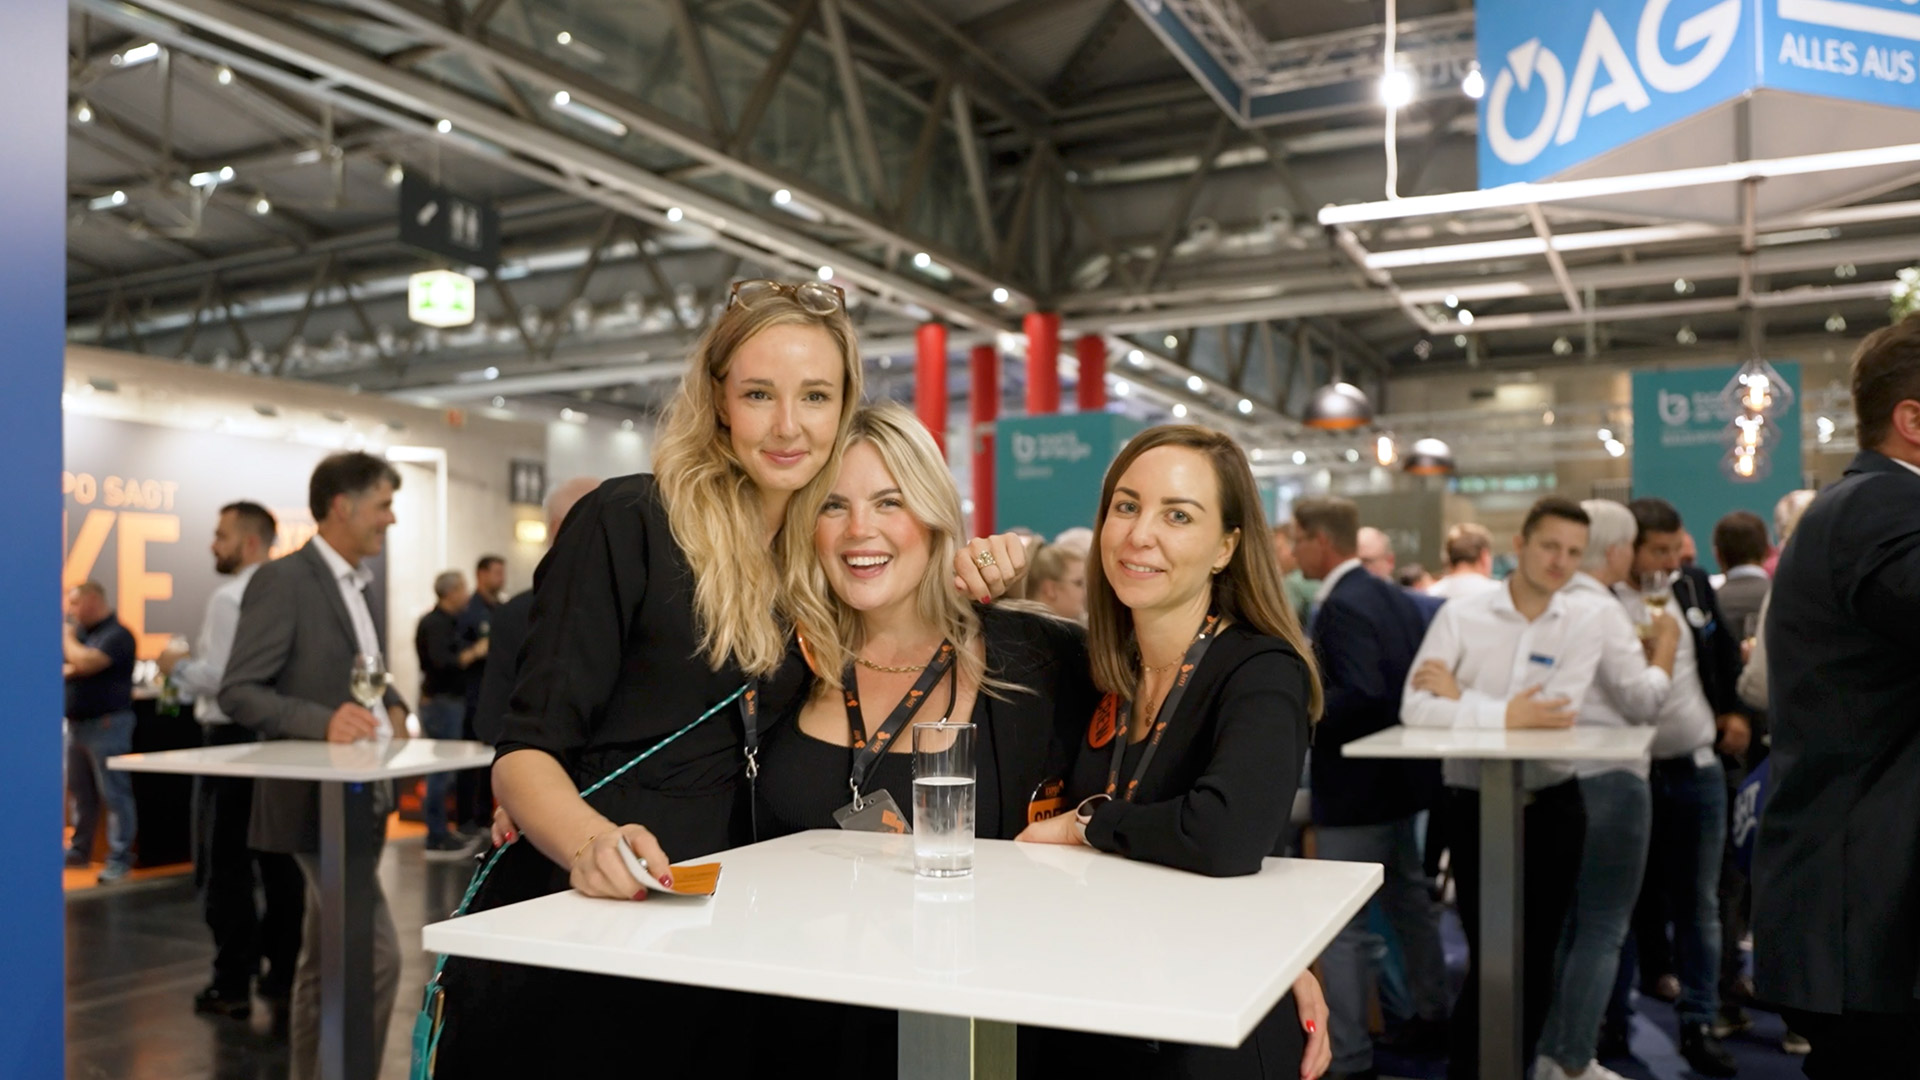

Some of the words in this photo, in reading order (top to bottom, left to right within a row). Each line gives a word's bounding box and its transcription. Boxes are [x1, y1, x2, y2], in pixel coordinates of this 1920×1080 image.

[1778, 31, 1859, 76] ALLES
[1861, 44, 1916, 84] AUS
[103, 475, 178, 511] SAGT
